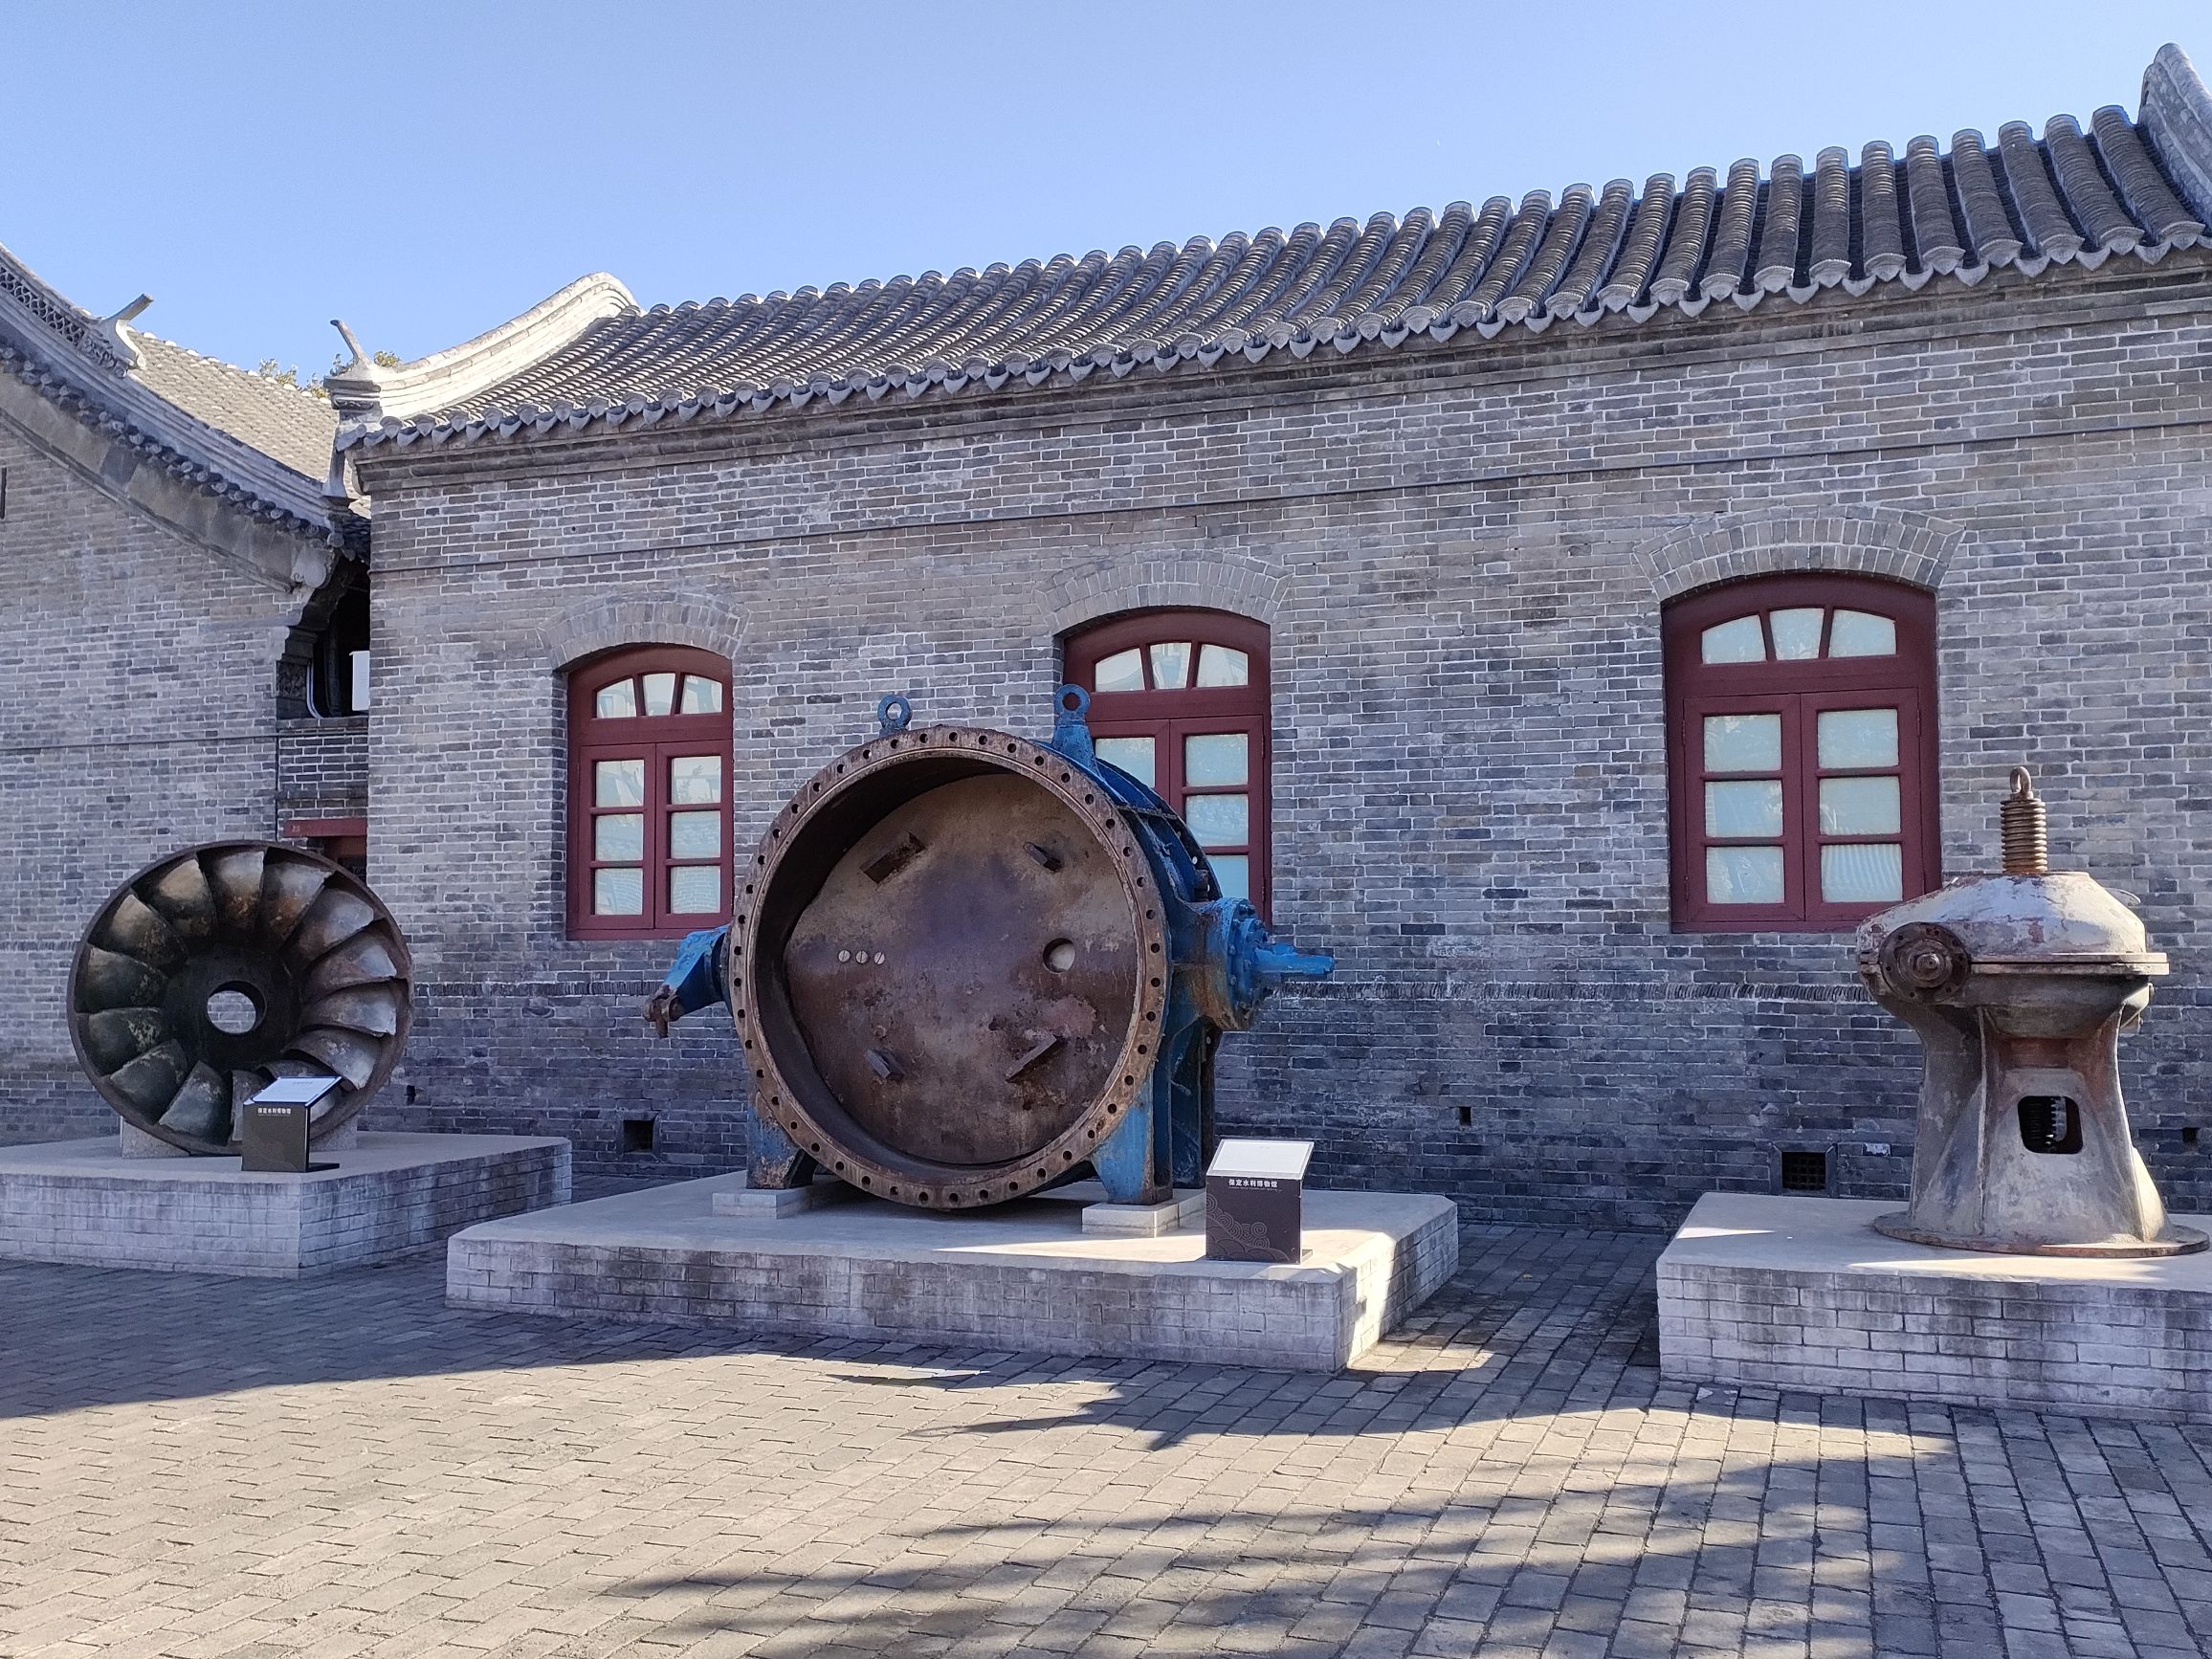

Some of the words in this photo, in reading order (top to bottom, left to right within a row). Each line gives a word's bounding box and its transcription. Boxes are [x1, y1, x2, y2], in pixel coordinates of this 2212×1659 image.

[1228, 1179, 1278, 1188] 保定水利博物馆
